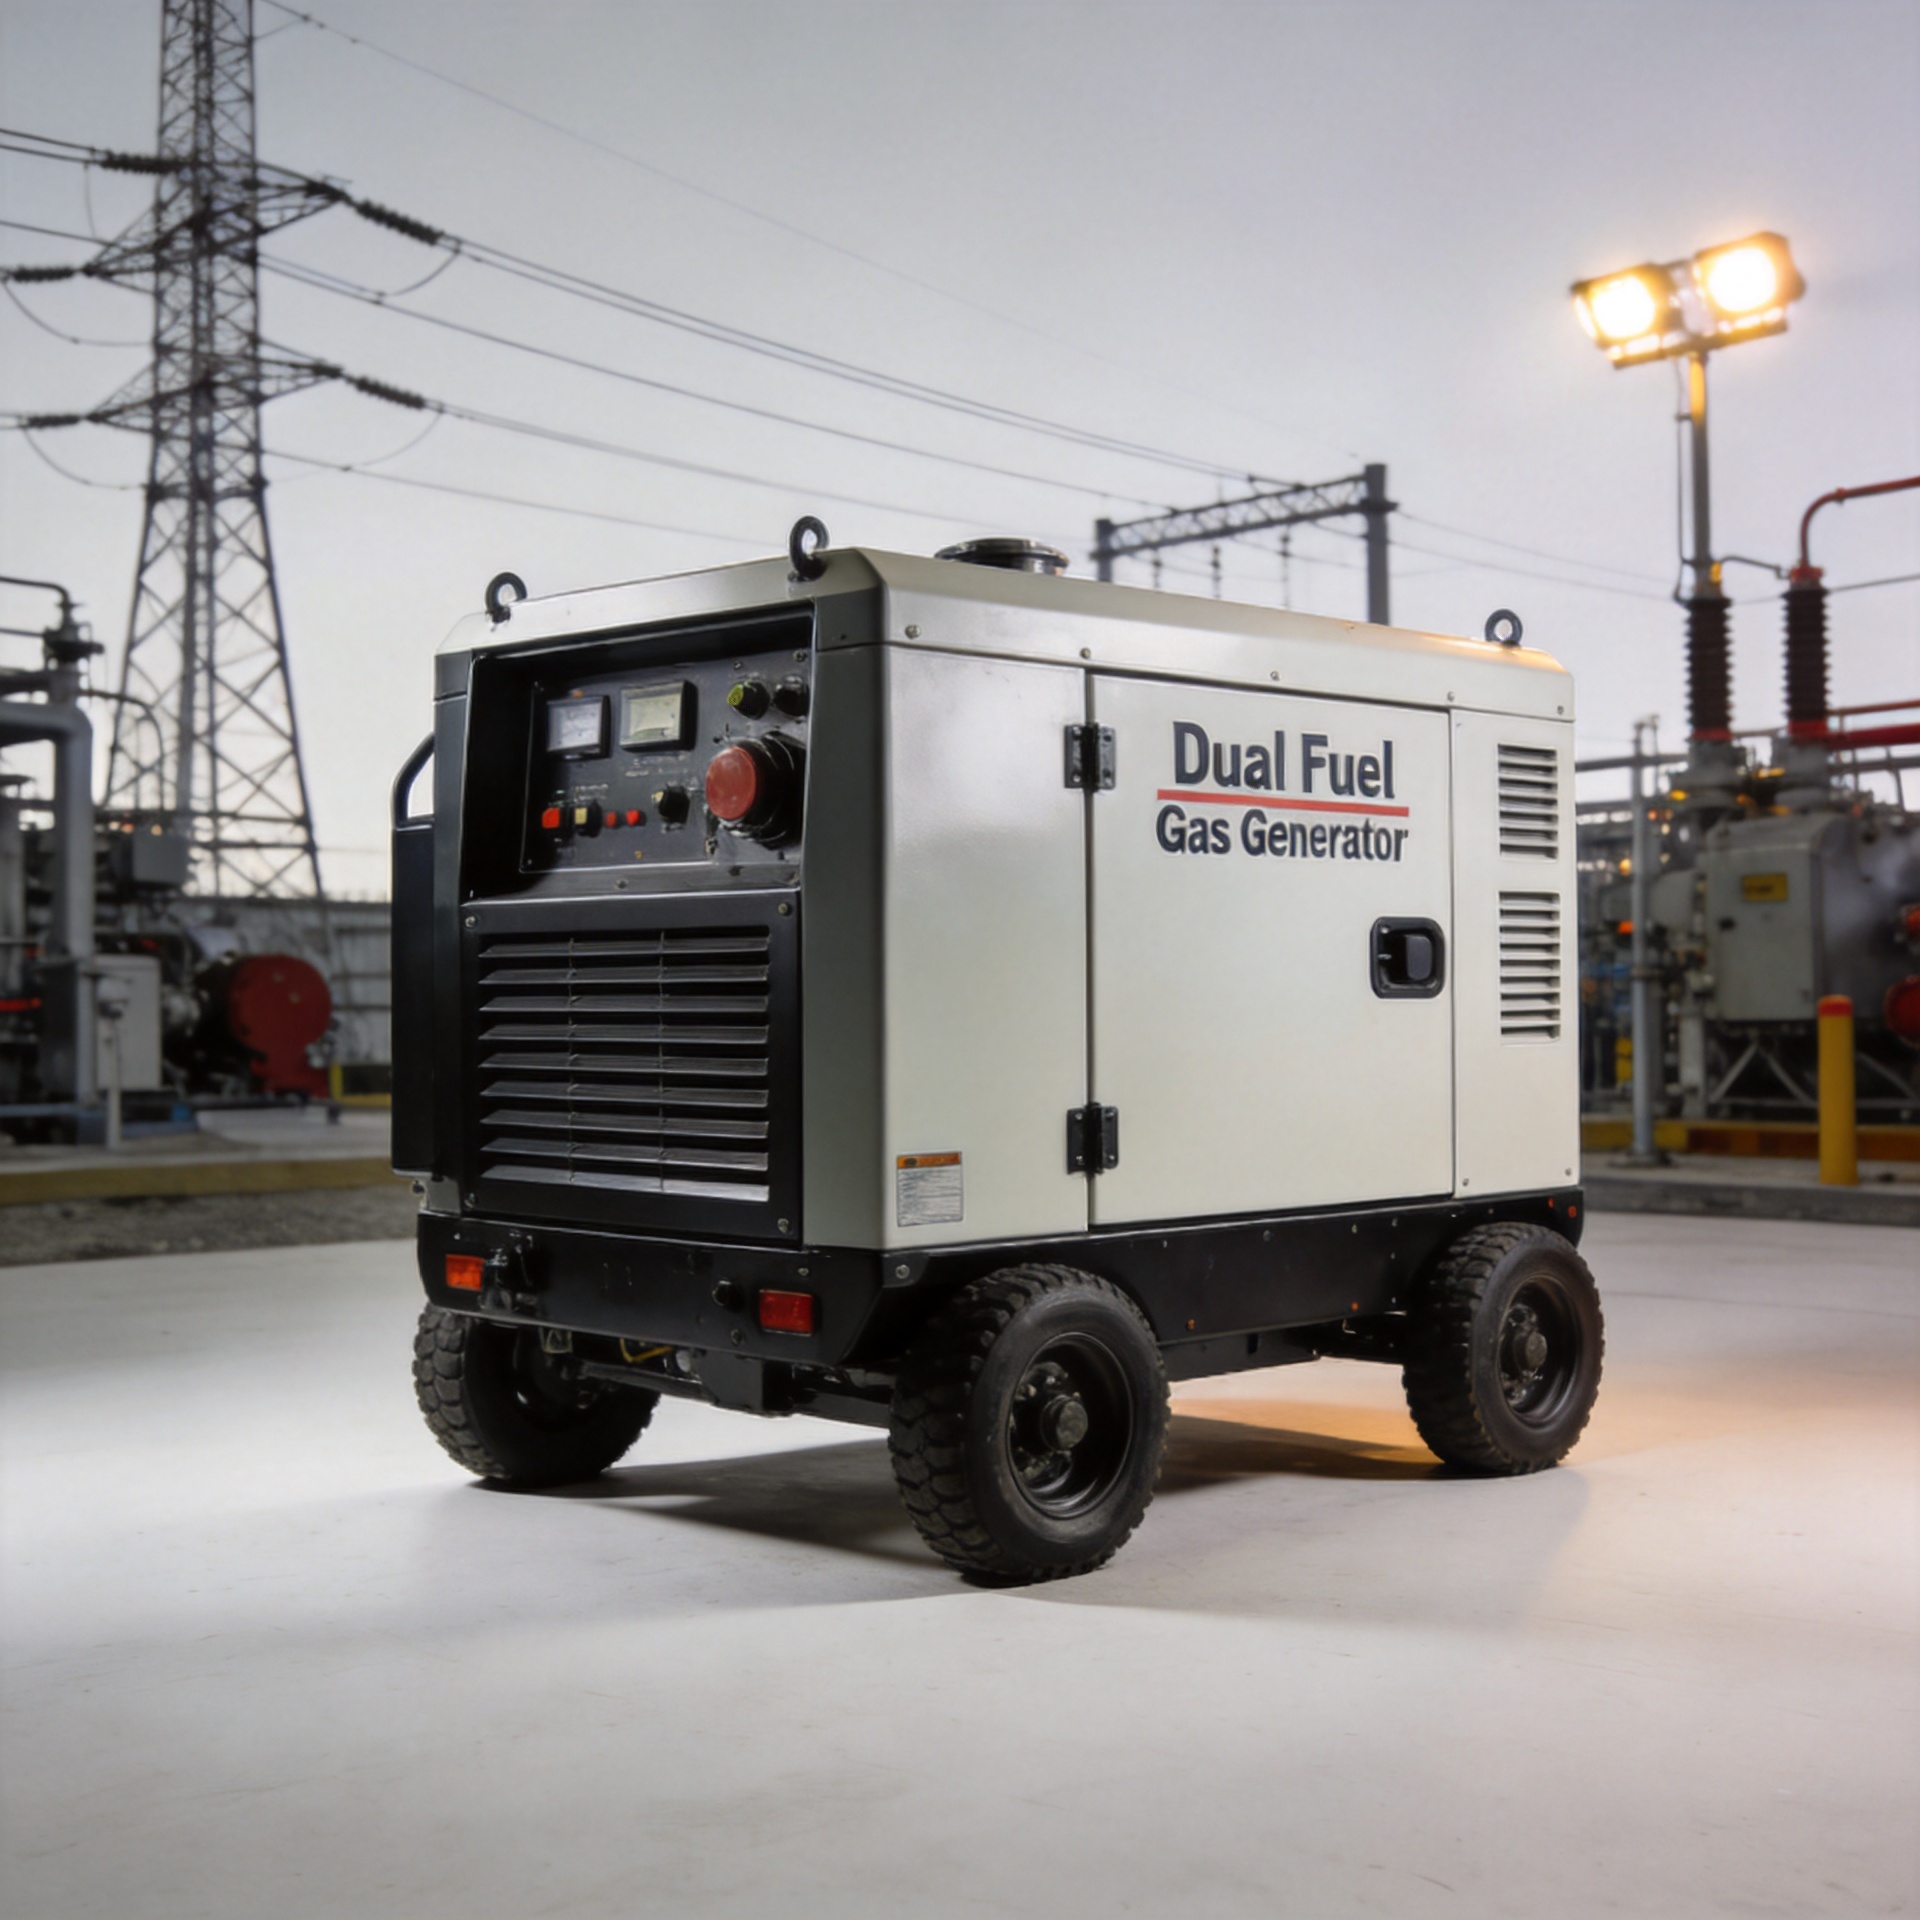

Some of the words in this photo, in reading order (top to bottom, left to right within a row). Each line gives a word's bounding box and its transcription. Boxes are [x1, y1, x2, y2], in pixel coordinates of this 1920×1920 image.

[1172, 721, 1286, 791] Dual
[1301, 733, 1395, 799] Fuel
[1155, 804, 1232, 855] Gas
[1240, 808, 1409, 862] Generator
